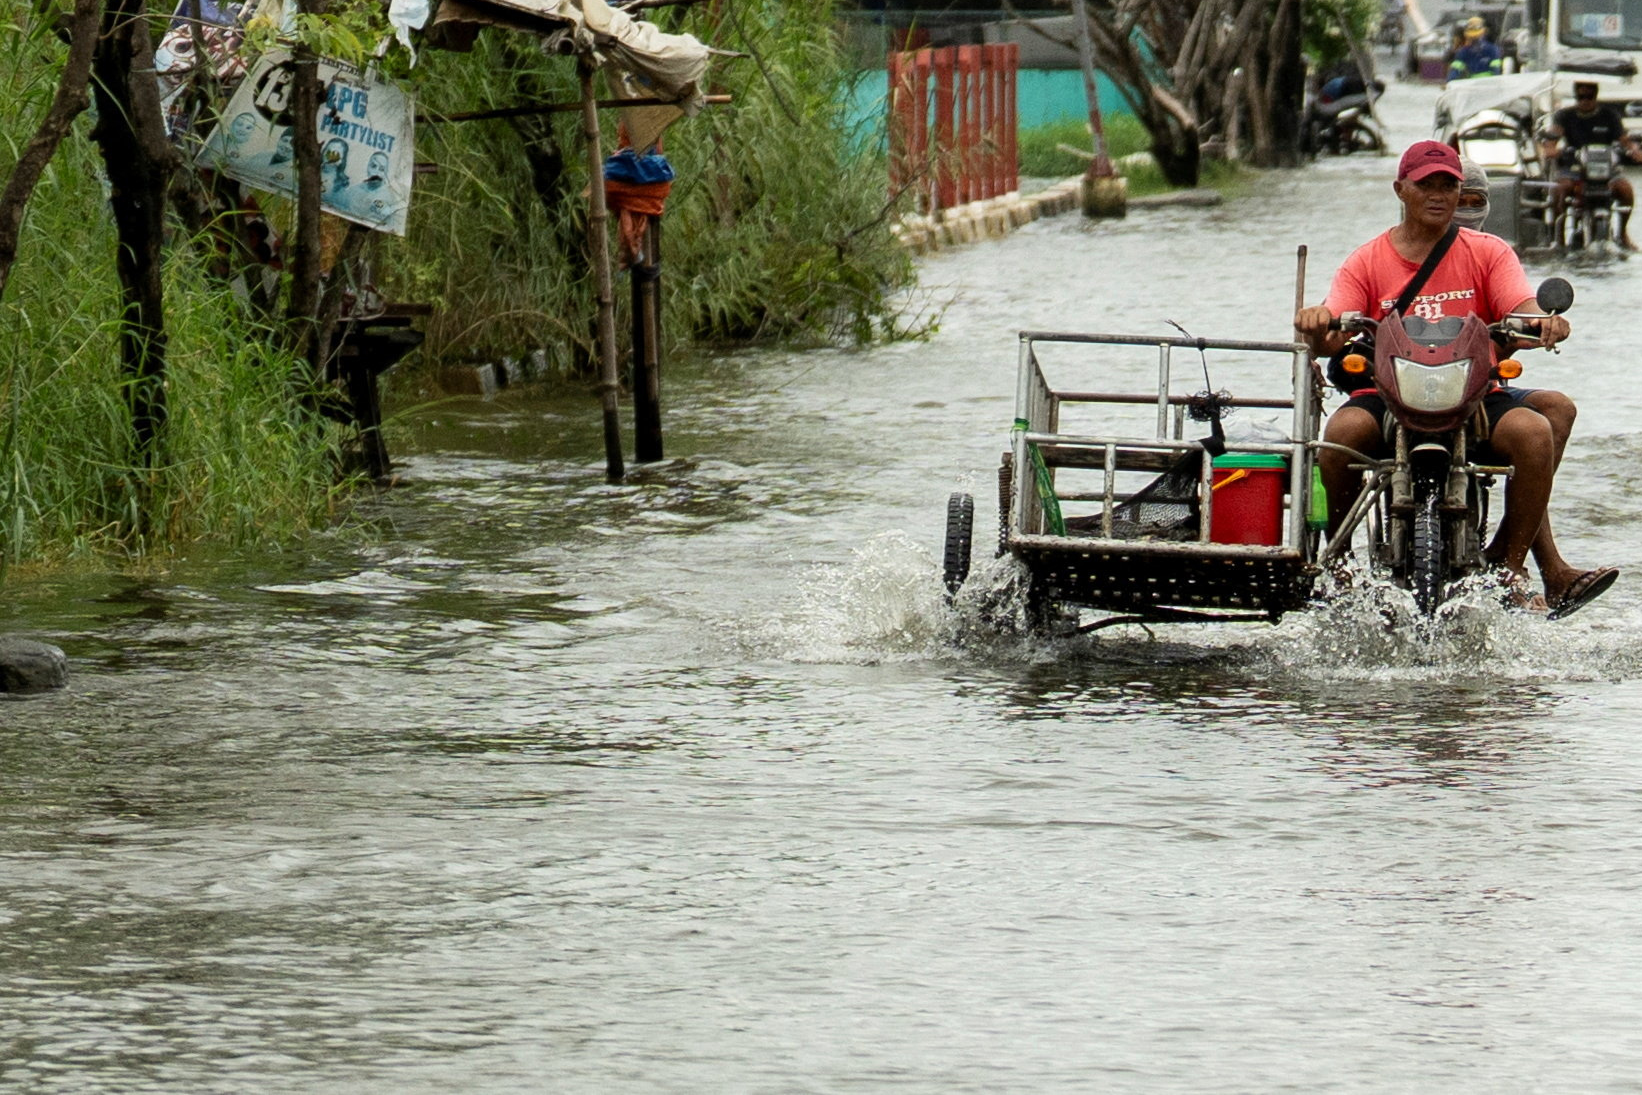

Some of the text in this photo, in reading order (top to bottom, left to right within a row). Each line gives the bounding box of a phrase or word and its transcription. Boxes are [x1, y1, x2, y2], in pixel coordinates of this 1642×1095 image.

[255, 67, 296, 112] 13
[320, 113, 396, 153] PARTYLIST
[1414, 303, 1446, 320] 81
